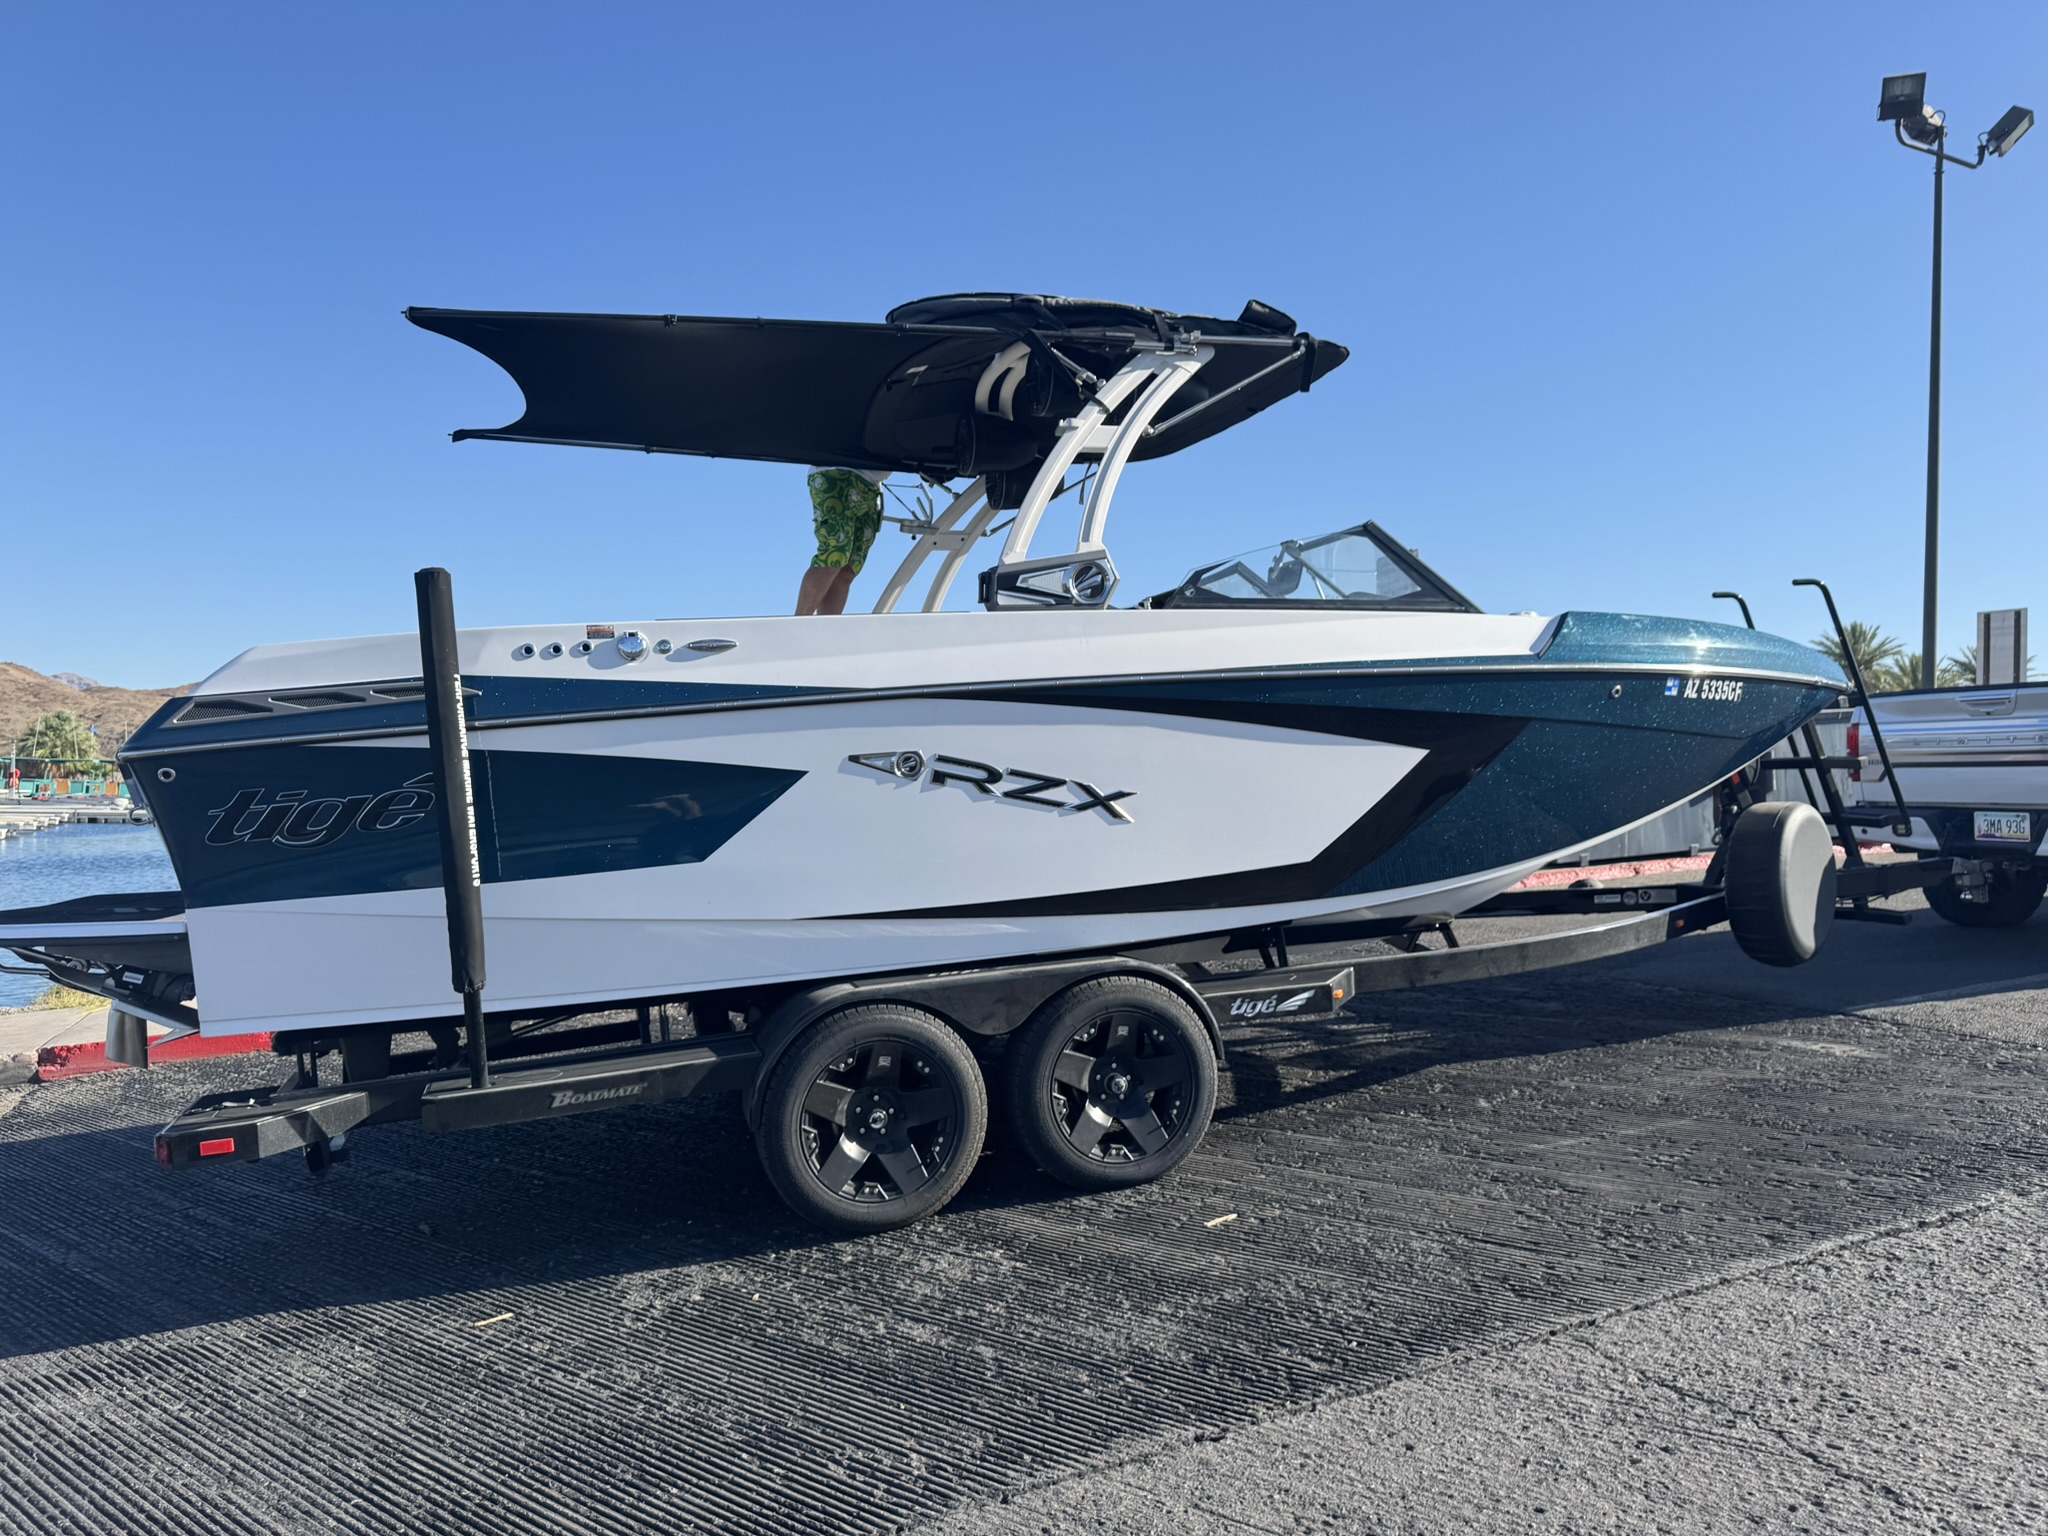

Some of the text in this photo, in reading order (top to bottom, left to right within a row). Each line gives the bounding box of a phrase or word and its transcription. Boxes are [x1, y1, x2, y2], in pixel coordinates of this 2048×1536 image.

[1683, 677, 1744, 703] AZ 5335CF
[929, 753, 1139, 824] RZX
[205, 772, 435, 849] tigé
[1983, 818, 2003, 834] 3MA
[1230, 994, 1278, 1017] tigé
